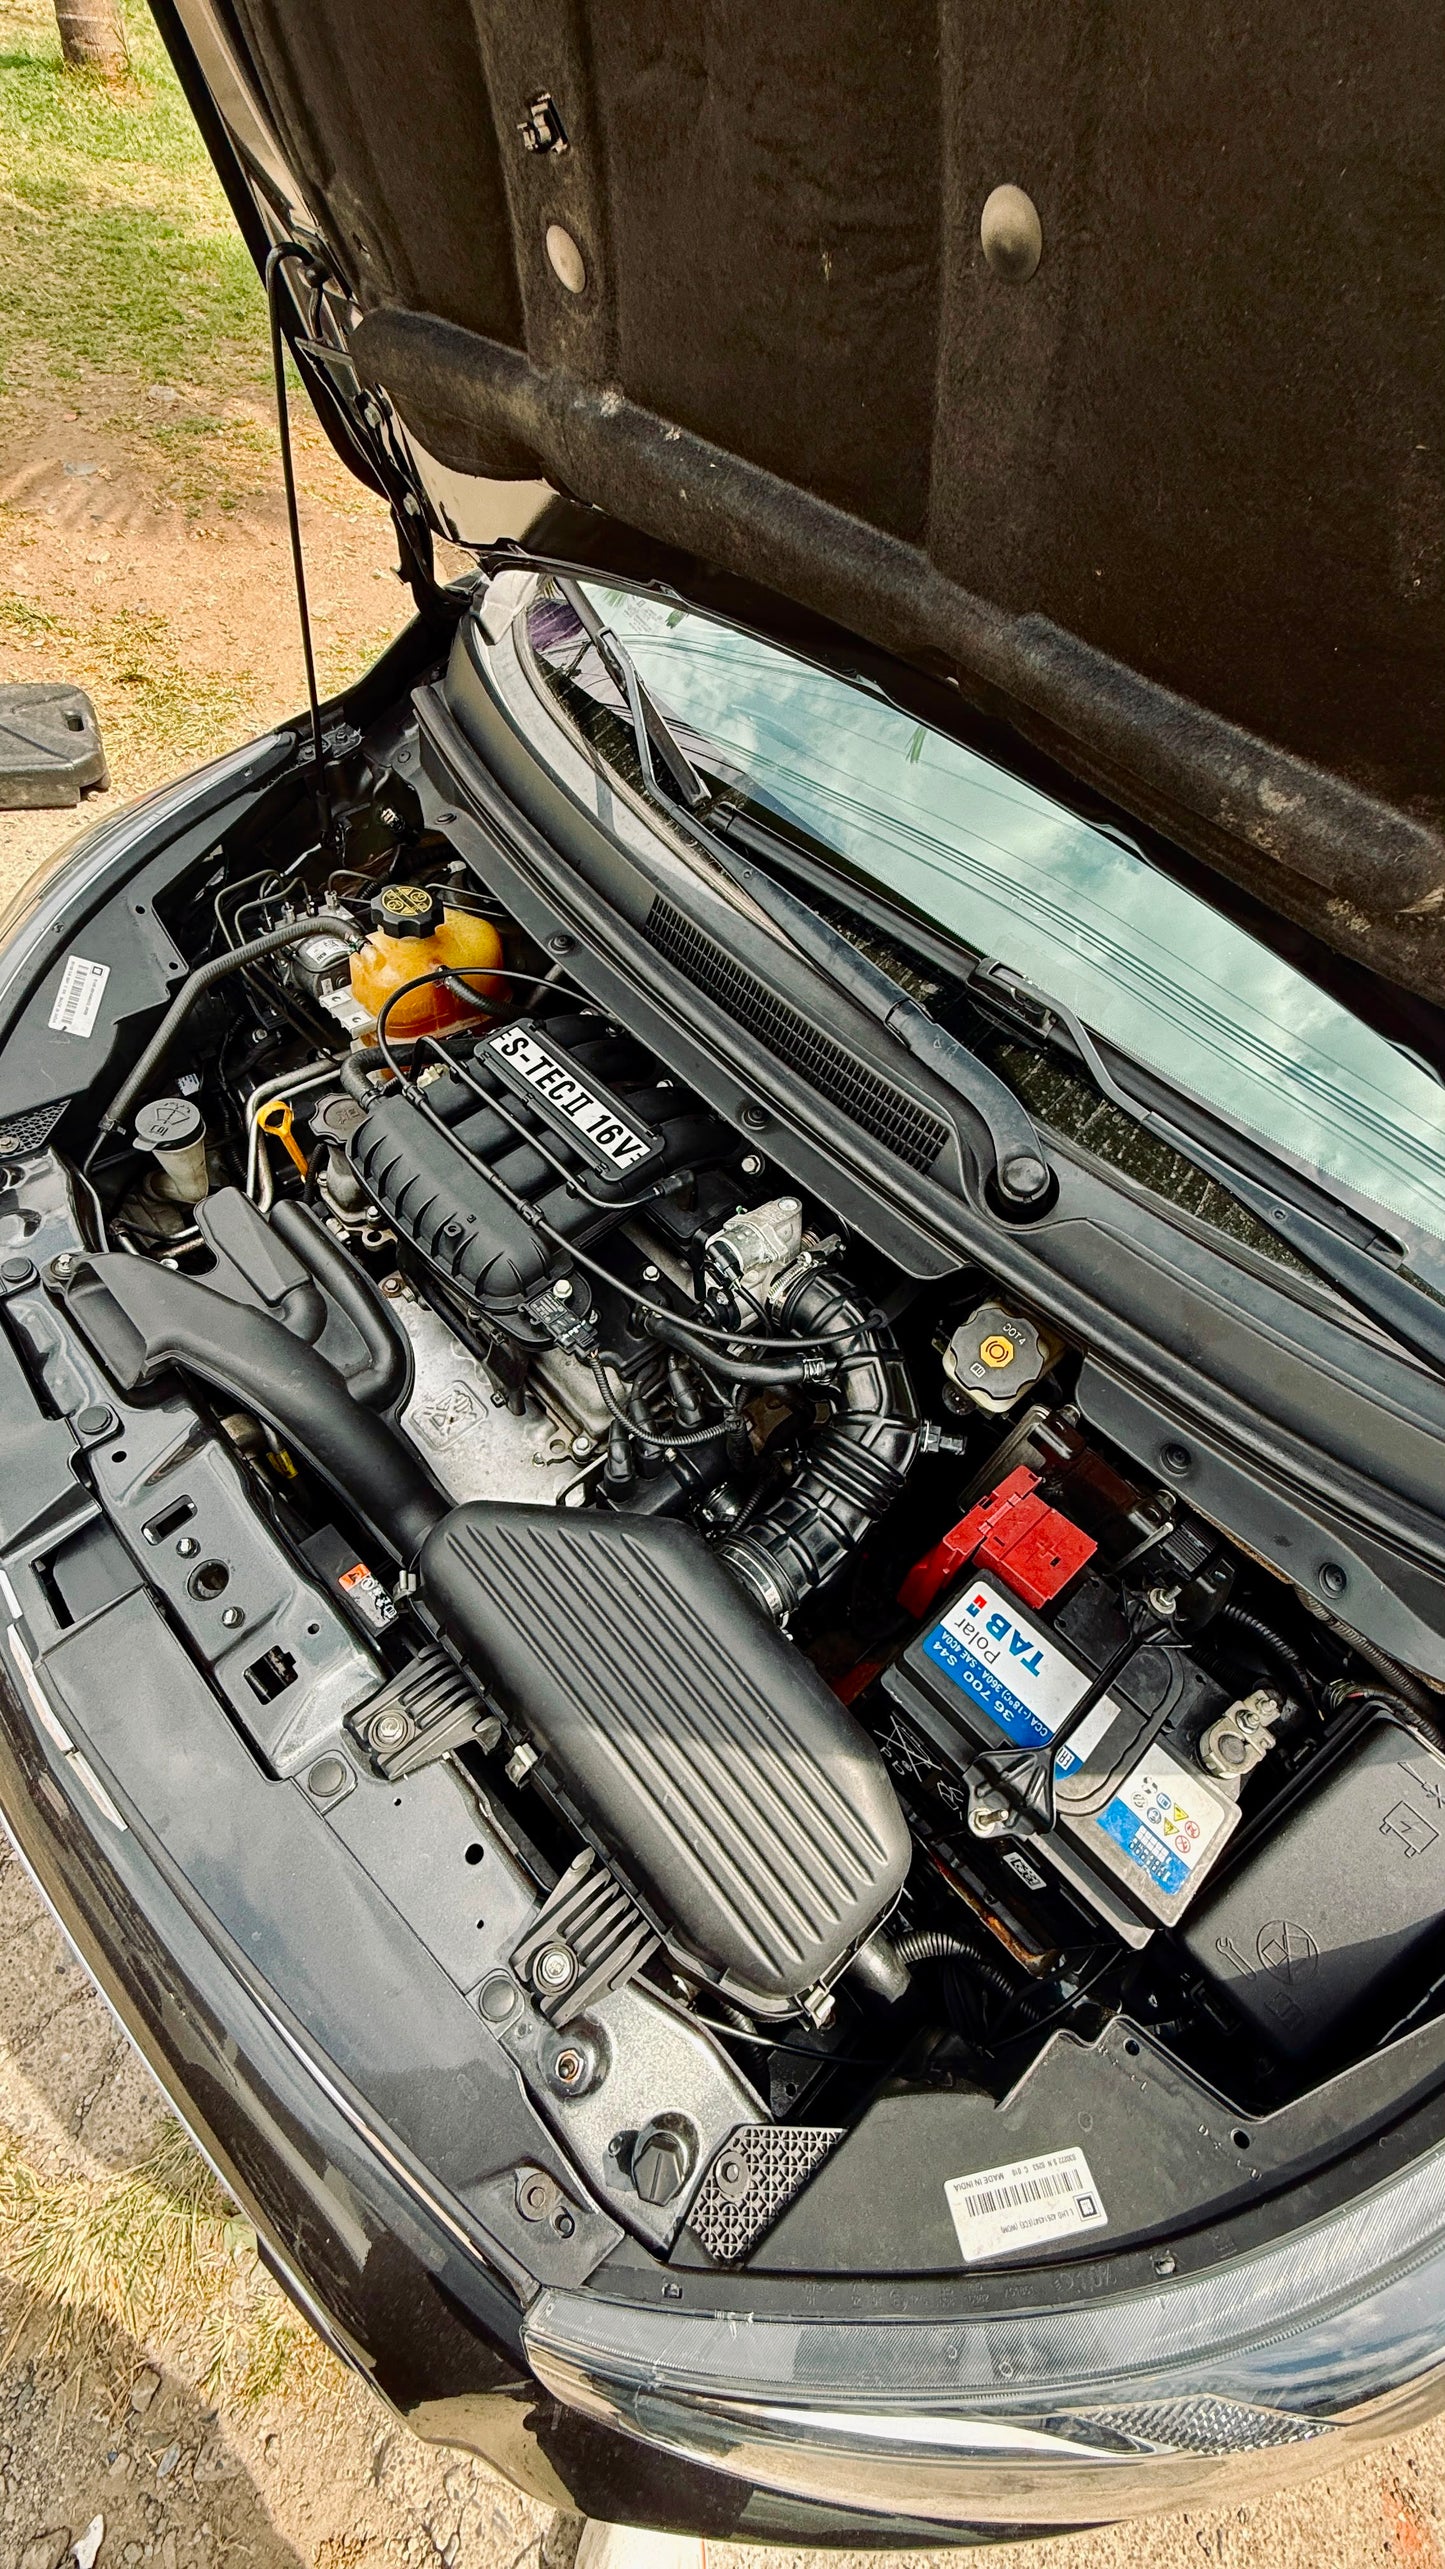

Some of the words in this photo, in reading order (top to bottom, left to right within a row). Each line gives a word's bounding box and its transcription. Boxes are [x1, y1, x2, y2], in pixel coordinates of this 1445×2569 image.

[586, 1114, 642, 1159] 16V
[954, 1617, 1000, 1664] Polar
[986, 1612, 1044, 1677] TAB
[932, 1641, 957, 1667] S44
[960, 1650, 978, 1666] SAE
[962, 1671, 991, 1701] 700
[982, 1672, 1003, 1692] 360A
[994, 1701, 1015, 1723] 36
[1030, 1717, 1049, 1737] CCA
[953, 2180, 974, 2192] INDIA
[974, 2178, 982, 2186] IN
[982, 2172, 1005, 2185] MADE
